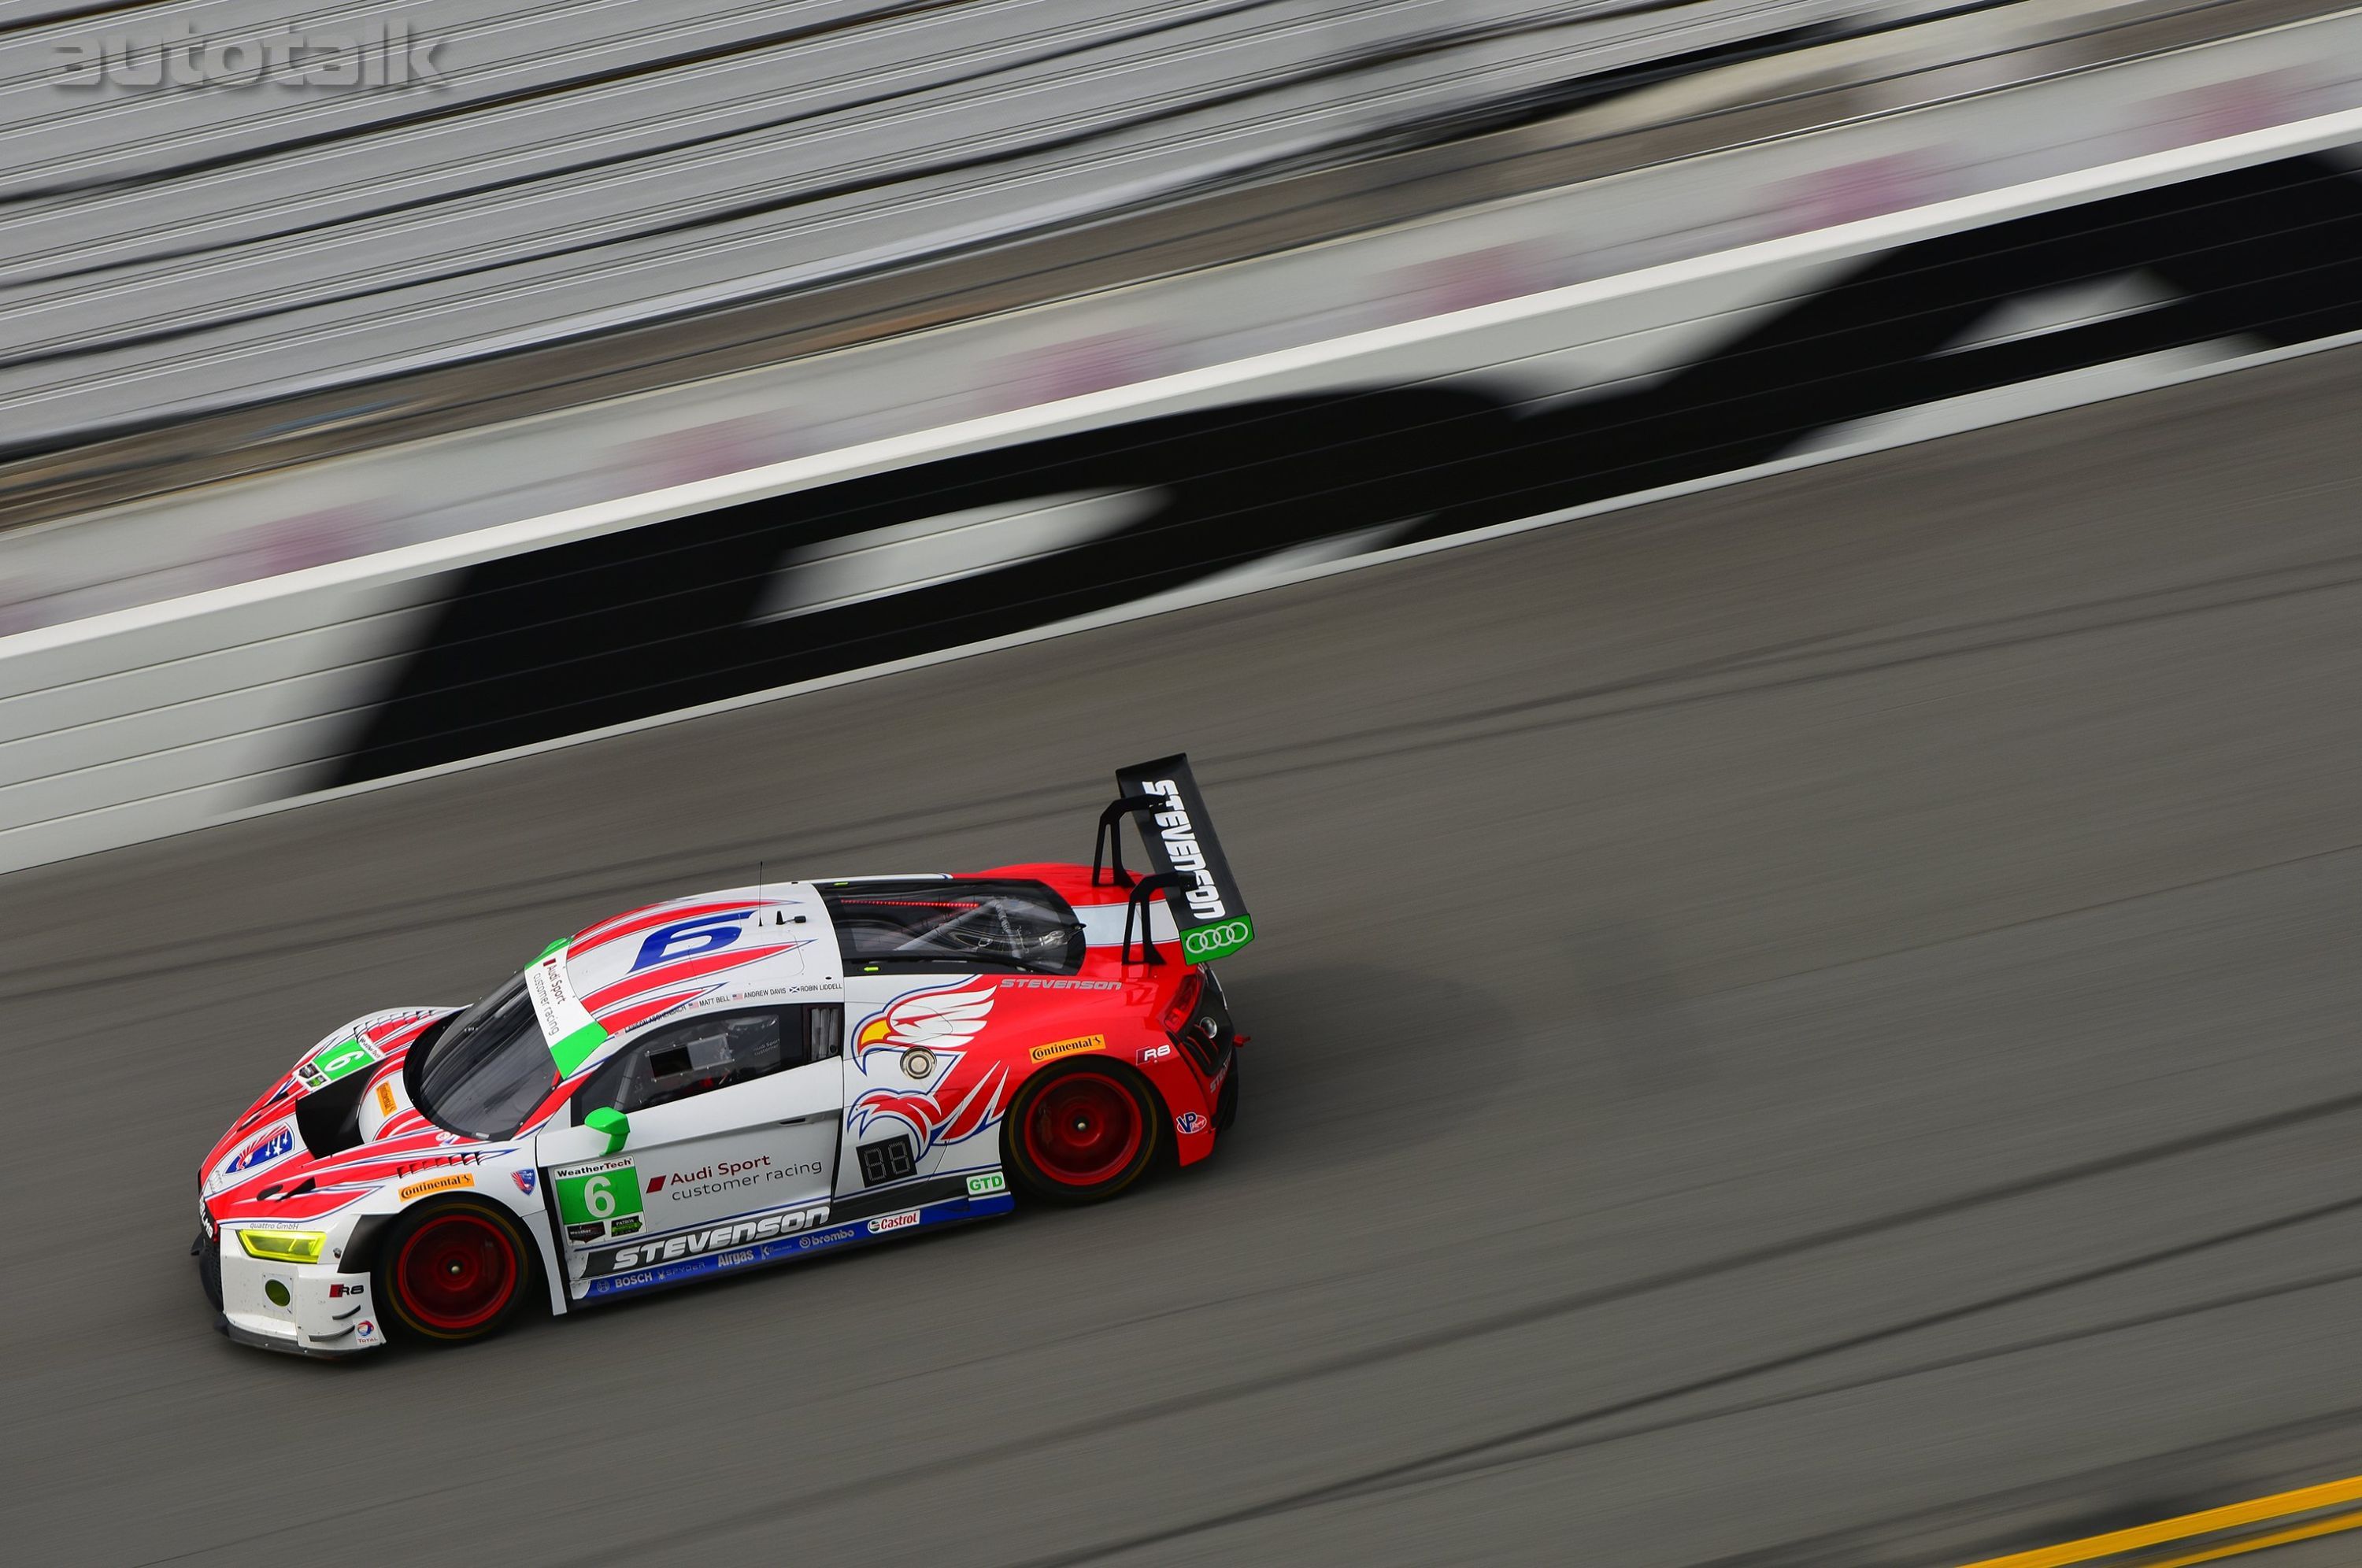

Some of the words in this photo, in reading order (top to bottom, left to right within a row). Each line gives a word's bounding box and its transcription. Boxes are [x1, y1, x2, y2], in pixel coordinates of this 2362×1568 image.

[626, 909, 758, 974] 6
[547, 964, 560, 982] Audi
[551, 979, 566, 1004] Sport
[744, 989, 768, 999] ANDREW
[771, 987, 787, 996] DAVIS
[1000, 978, 1122, 990] STEVENSON
[534, 973, 550, 1006] customer
[544, 1008, 560, 1036] racing
[699, 997, 714, 1007] MATT
[716, 995, 731, 1004] BELL
[1032, 1037, 1093, 1060] Continental
[1144, 1045, 1171, 1061] R8
[324, 1050, 365, 1072] 6
[1176, 1112, 1197, 1133] VP
[557, 1158, 631, 1177] WeatherTech
[671, 1166, 713, 1185] Audi
[718, 1155, 771, 1176] Sport
[401, 1178, 461, 1199] Continental
[672, 1174, 760, 1201] customer
[766, 1161, 823, 1182] racing
[969, 1175, 1004, 1191] GTD
[584, 1175, 616, 1218] 6
[881, 1212, 917, 1230] Castrol
[613, 1205, 830, 1270] STEVENSON
[813, 1230, 855, 1245] brembo
[717, 1249, 754, 1267] Airgas
[615, 1272, 653, 1289] BOSCH
[340, 1285, 364, 1296] R8
